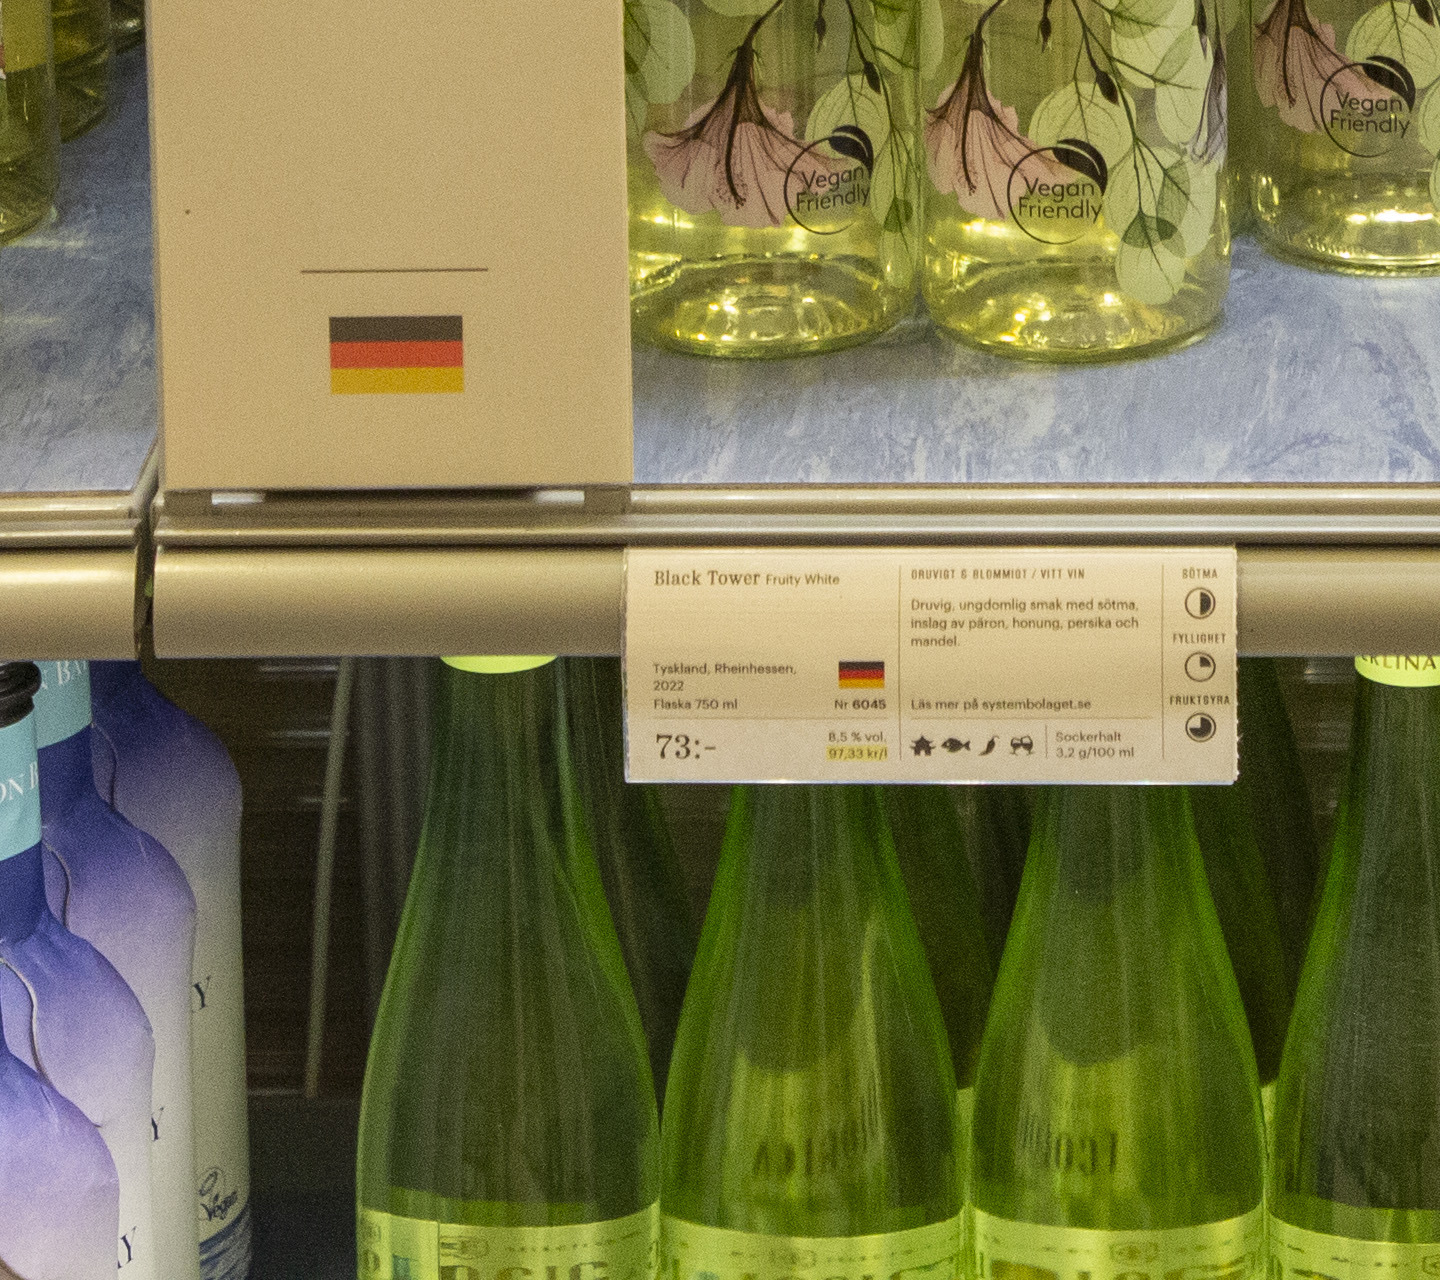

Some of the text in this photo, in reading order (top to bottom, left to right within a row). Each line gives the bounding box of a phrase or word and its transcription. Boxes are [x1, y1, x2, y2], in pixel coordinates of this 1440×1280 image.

[654, 568, 840, 587] Black Tower Fruity White
[653, 680, 684, 691] 2022
[834, 698, 886, 710] Nr 6045
